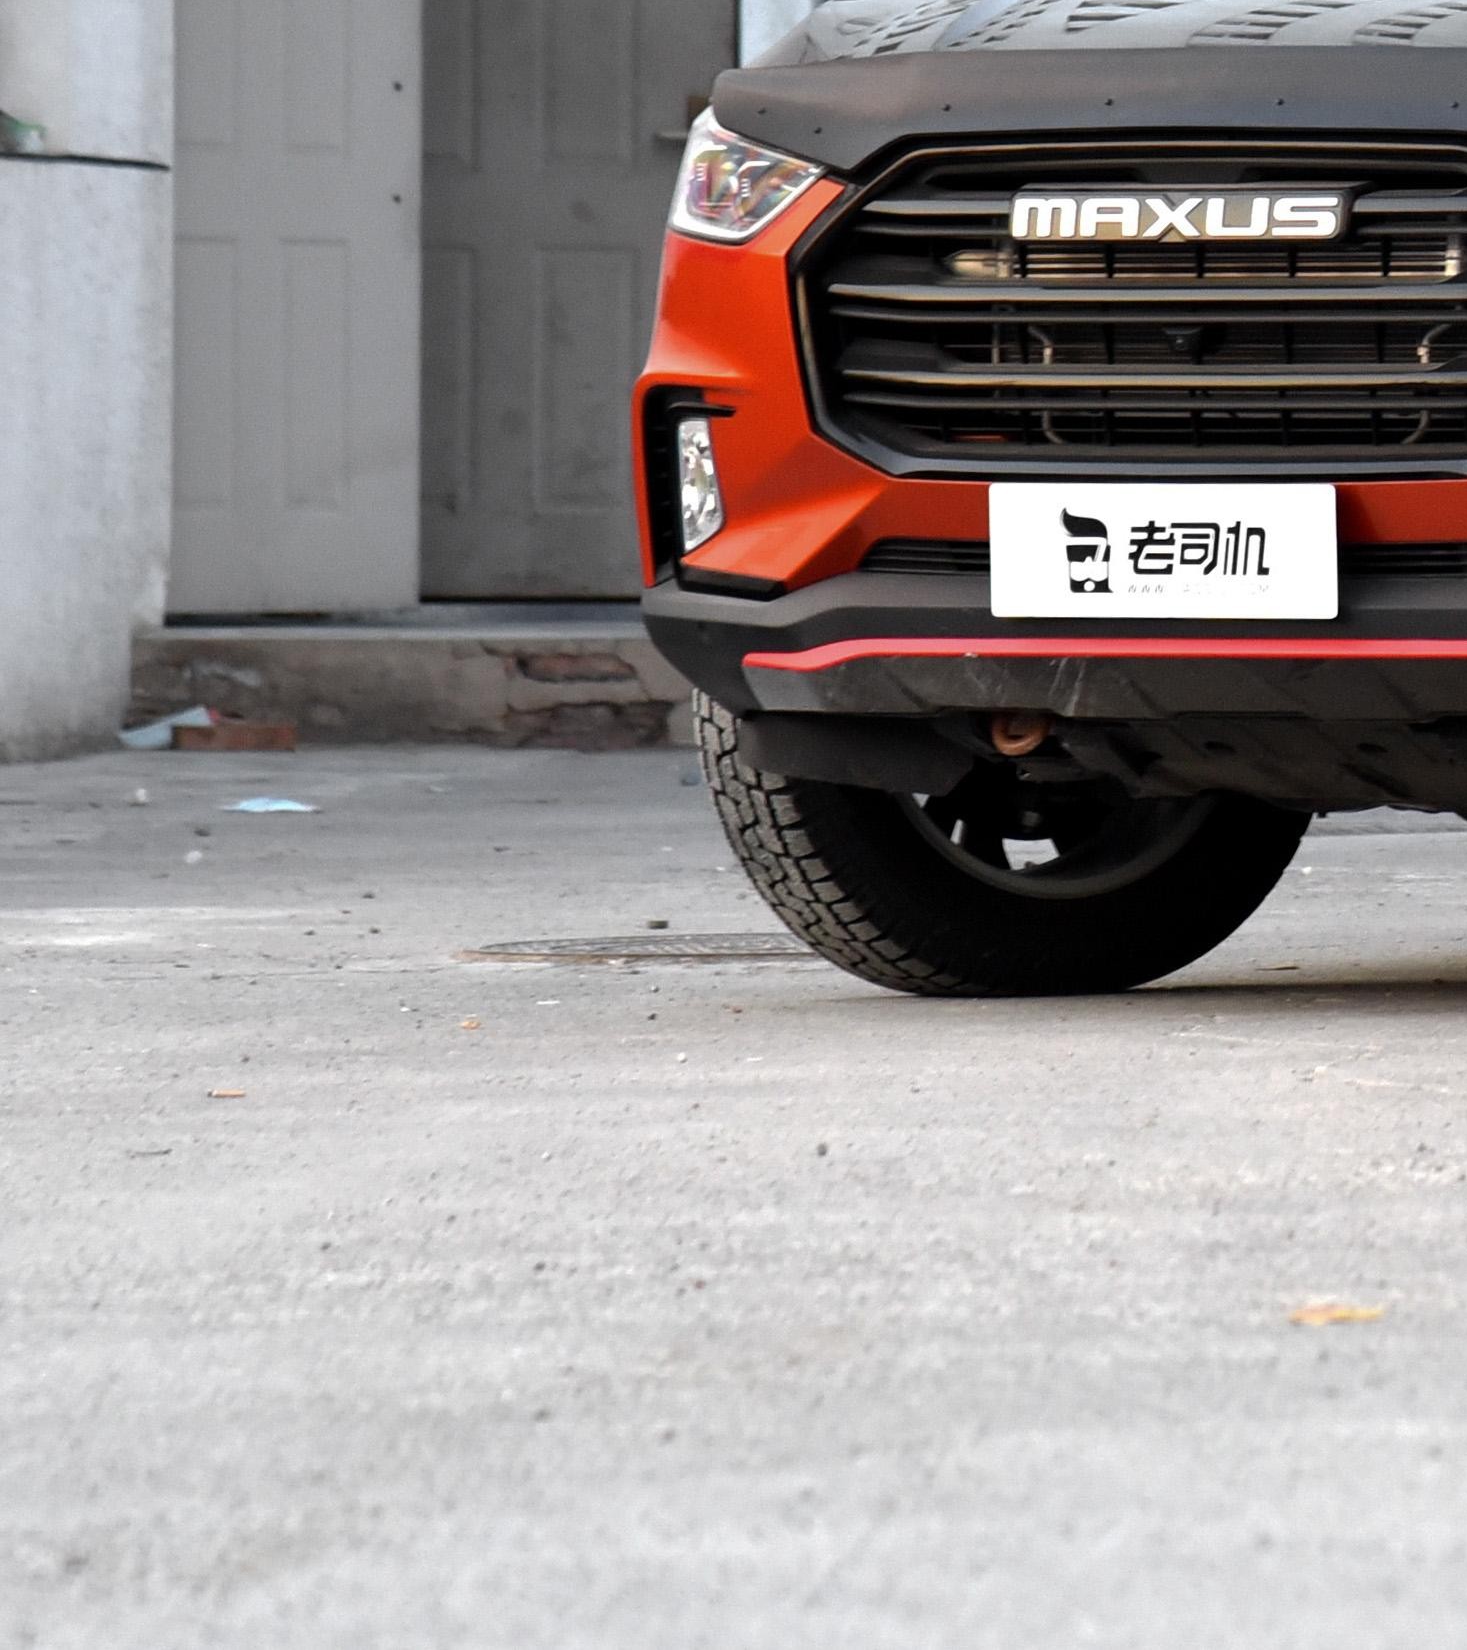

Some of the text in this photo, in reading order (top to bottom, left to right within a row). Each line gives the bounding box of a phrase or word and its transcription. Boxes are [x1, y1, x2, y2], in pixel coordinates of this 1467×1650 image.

[1011, 196, 1340, 238] MAXUS
[1127, 519, 1271, 577] 老司机
